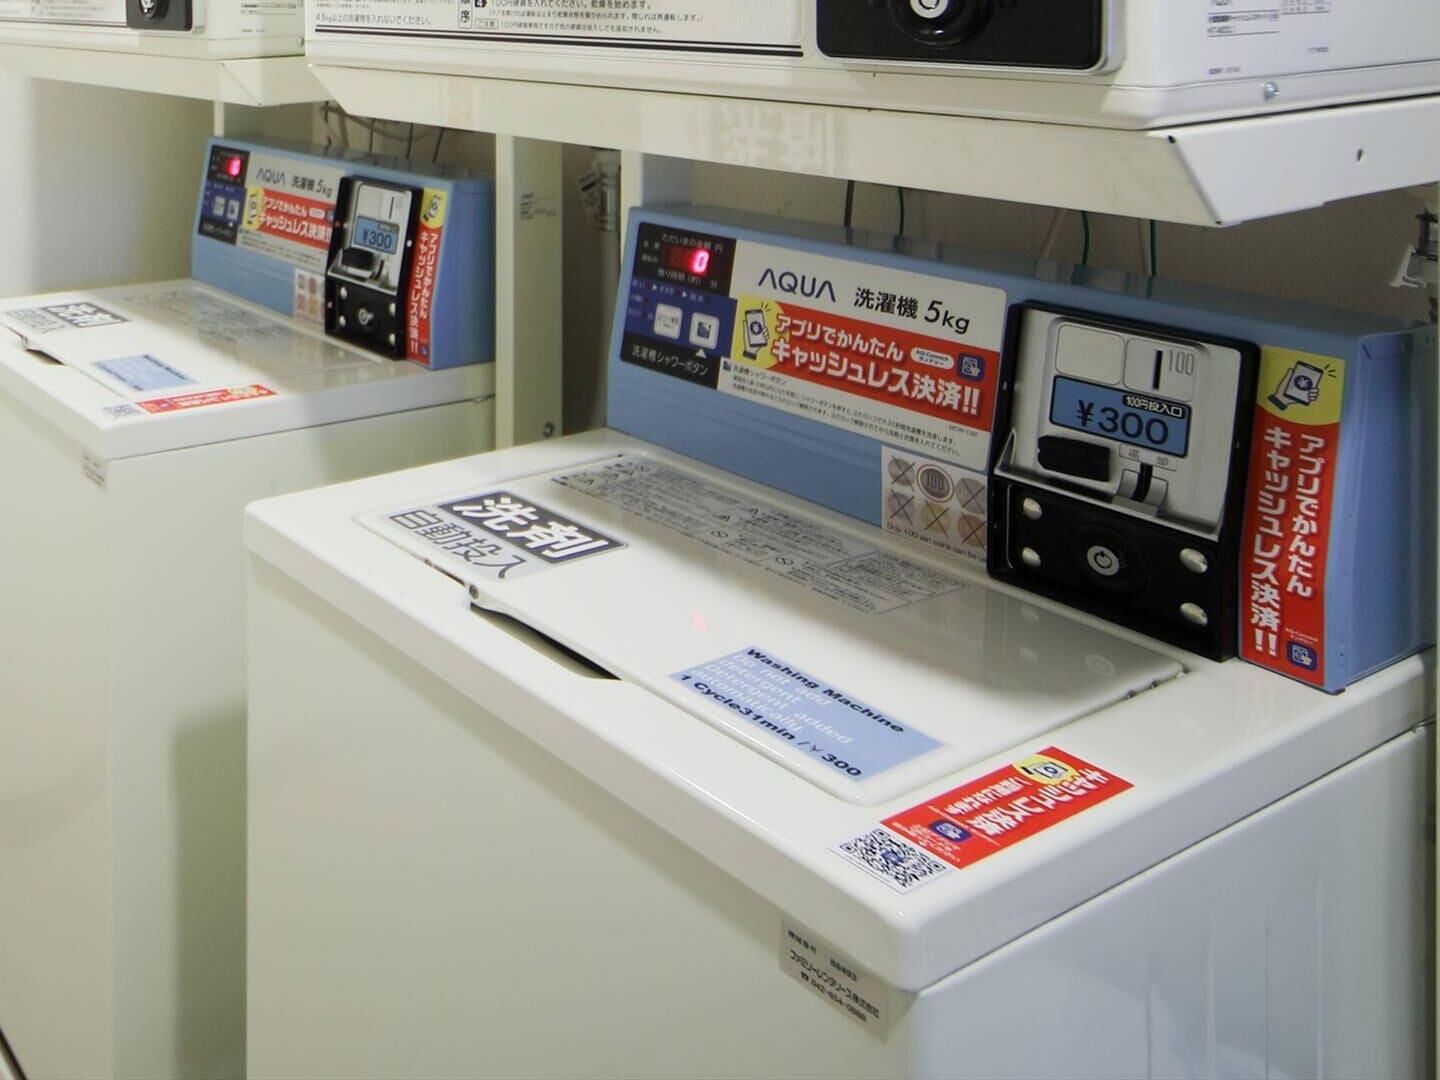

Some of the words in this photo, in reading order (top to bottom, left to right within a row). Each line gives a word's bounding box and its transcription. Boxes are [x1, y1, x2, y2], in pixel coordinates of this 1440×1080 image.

[256, 168, 286, 185] AQUA
[362, 229, 392, 250] ¥300
[693, 250, 710, 274] 0
[758, 267, 837, 303] AQUA
[854, 286, 919, 320] 洗濯機
[923, 300, 971, 335] 5kg
[776, 313, 904, 362] アプリでかんたん
[772, 338, 981, 416] キャッシュレス決済!!
[1168, 349, 1196, 377] 100
[1076, 399, 1169, 445] ¥300
[1126, 396, 1183, 417] 100円投入口
[453, 497, 609, 558] 洗剤
[1286, 433, 1327, 599] アプリでかんたん
[389, 509, 527, 579] 自動投入
[1251, 426, 1292, 657] キャッシュレス決済!!
[747, 649, 820, 689] Washing
[823, 688, 904, 733] Machine
[795, 686, 833, 706] add
[793, 711, 854, 745] added
[821, 753, 862, 777] 300
[969, 768, 1109, 837] キャッシュレス決済
